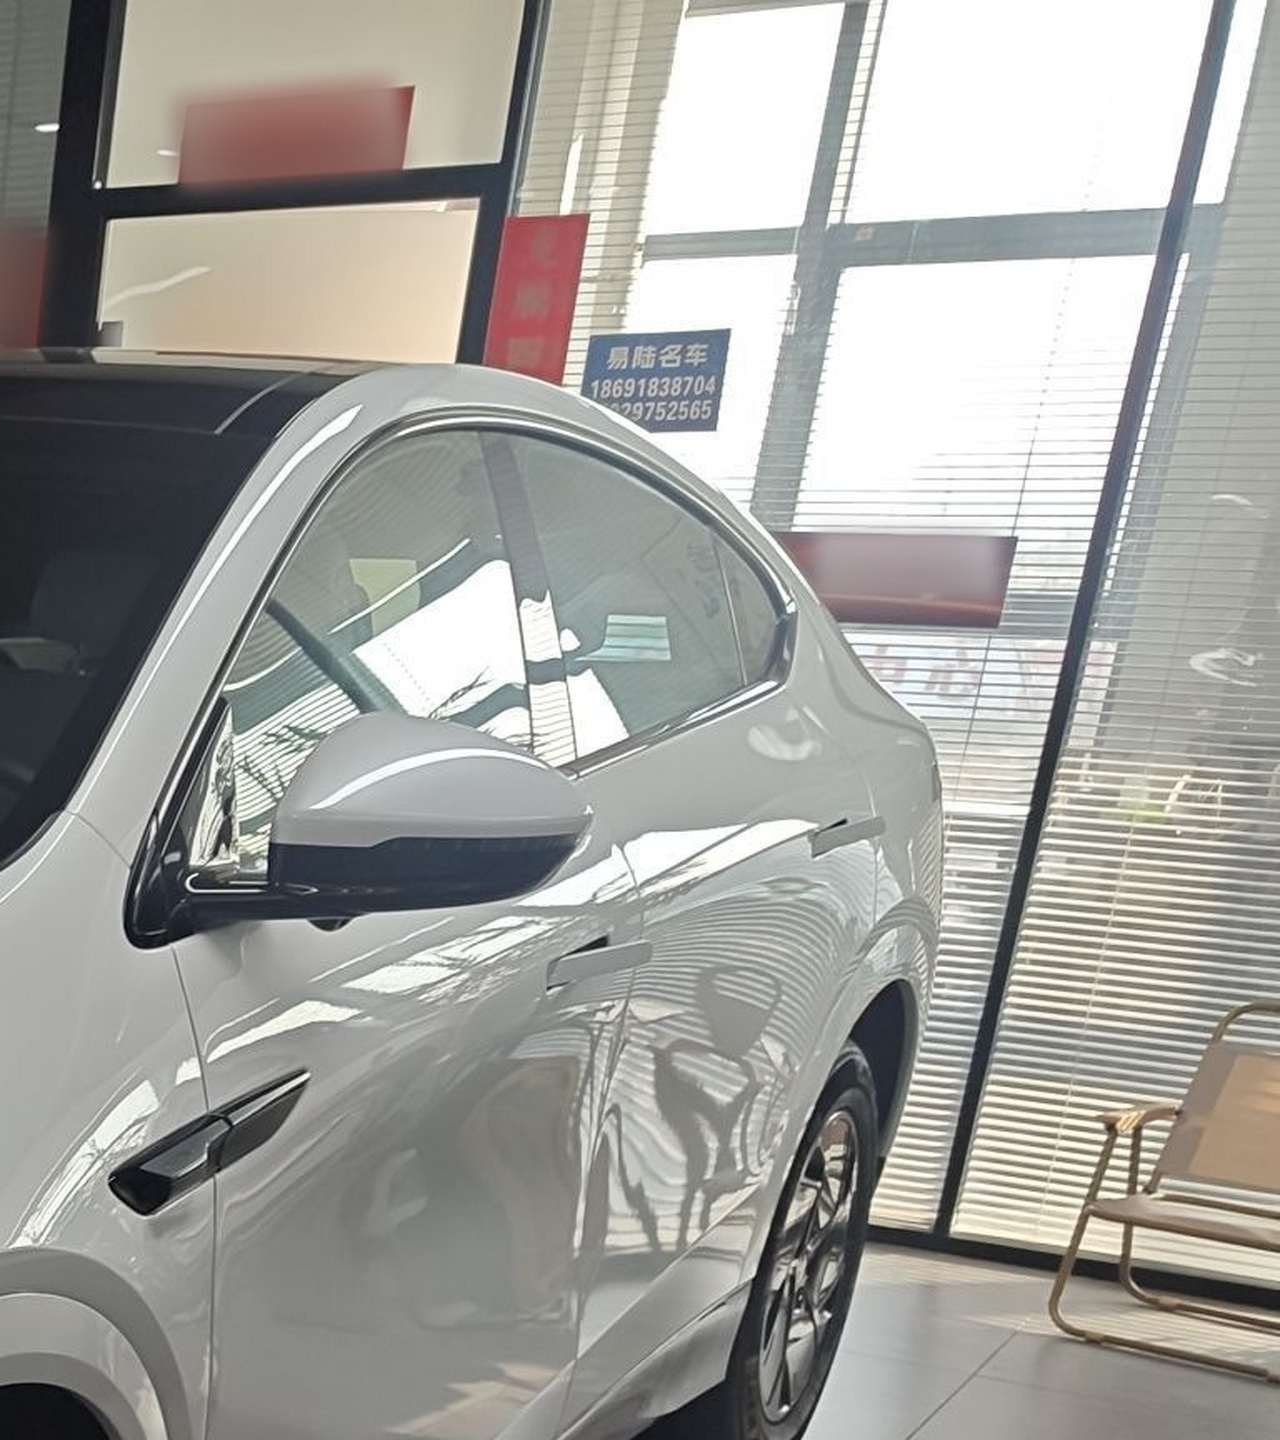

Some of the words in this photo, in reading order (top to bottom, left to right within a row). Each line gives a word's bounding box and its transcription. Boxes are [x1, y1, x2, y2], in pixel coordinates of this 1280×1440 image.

[607, 343, 709, 370] 易陆名车
[591, 375, 716, 399] 18691838704
